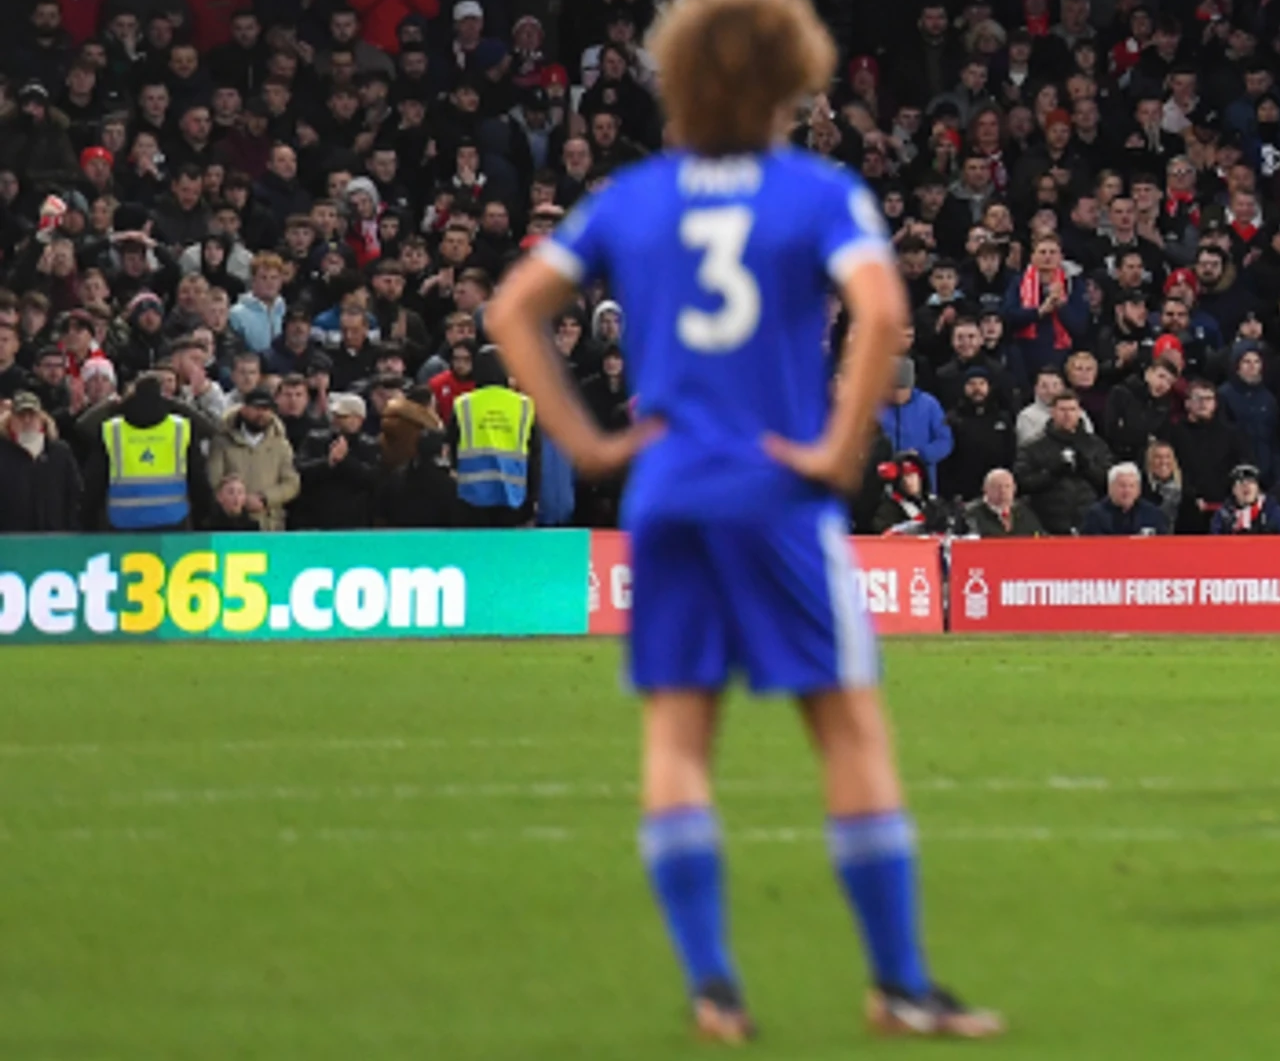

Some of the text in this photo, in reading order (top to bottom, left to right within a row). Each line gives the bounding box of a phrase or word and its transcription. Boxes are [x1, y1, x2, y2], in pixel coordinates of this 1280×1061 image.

[680, 205, 760, 351] 3
[1000, 578, 1121, 606] NOTTINGHAM
[1125, 578, 1197, 606] FOREST
